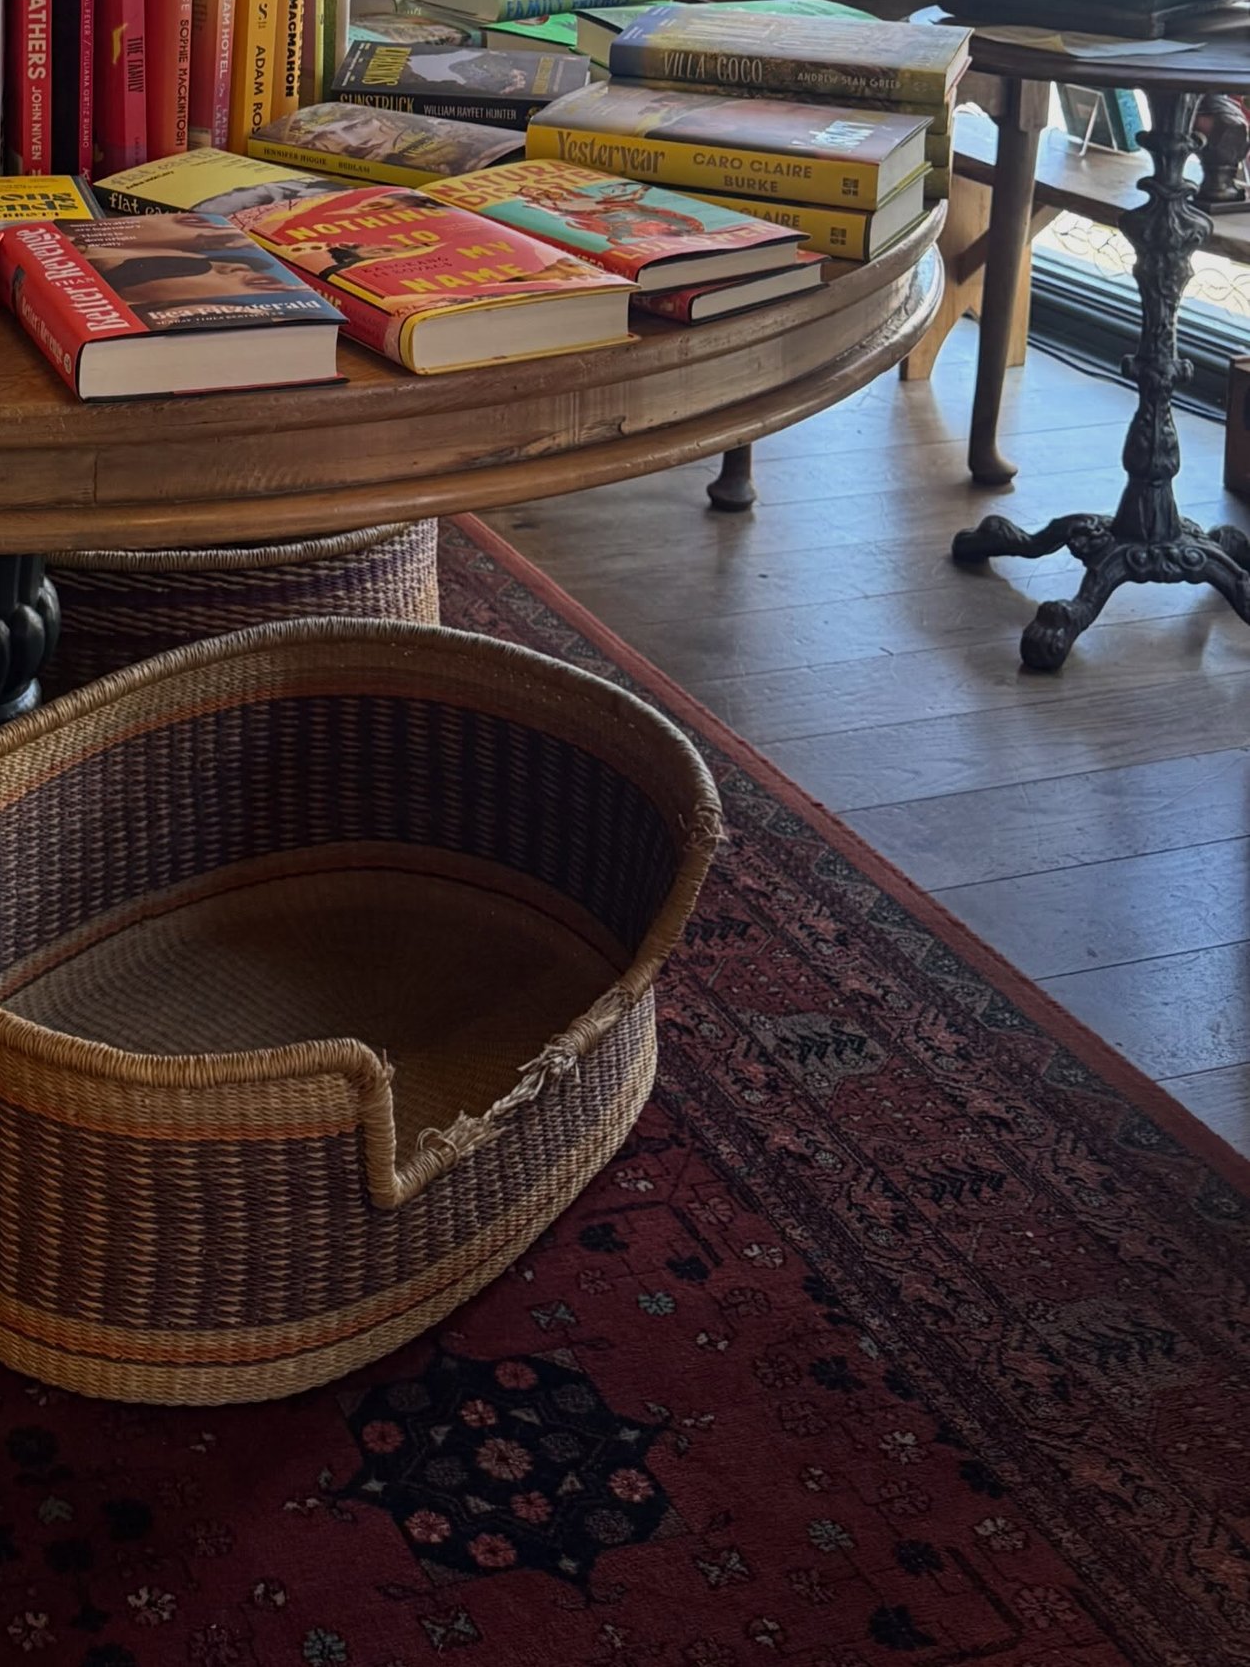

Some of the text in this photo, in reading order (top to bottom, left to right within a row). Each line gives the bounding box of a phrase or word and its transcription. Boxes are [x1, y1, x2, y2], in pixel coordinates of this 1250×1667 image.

[83, 9, 91, 35] FEVER
[178, 19, 189, 63] SOPHIE
[219, 27, 230, 79] HOTEL
[127, 35, 144, 93] THE FAMILY
[252, 45, 267, 96] ADAM
[663, 51, 707, 80] VILLA
[716, 57, 764, 85] COCO
[797, 70, 837, 88] ANDREW
[839, 73, 867, 88] SEAN
[31, 86, 43, 117] JOHN
[175, 68, 188, 147] MACKINTOSH
[252, 102, 264, 134] ROS
[339, 93, 415, 115] SUNSTRUCK
[423, 103, 458, 117] WILLIAM
[485, 107, 517, 120] HUNTER
[31, 119, 42, 161] NIVEN
[263, 146, 299, 163] JENNIFER
[301, 153, 327, 166] HIGGIE
[556, 130, 667, 176] Yesteryear
[693, 152, 813, 179] CARO CLAIRE
[724, 174, 779, 194] BURKE
[108, 191, 141, 214] flat
[285, 205, 449, 241] NOTHING
[388, 229, 441, 248] TO
[15, 227, 86, 282] Revenge
[456, 240, 519, 260] MY
[400, 263, 526, 294] NAME
[67, 286, 131, 333] Better
